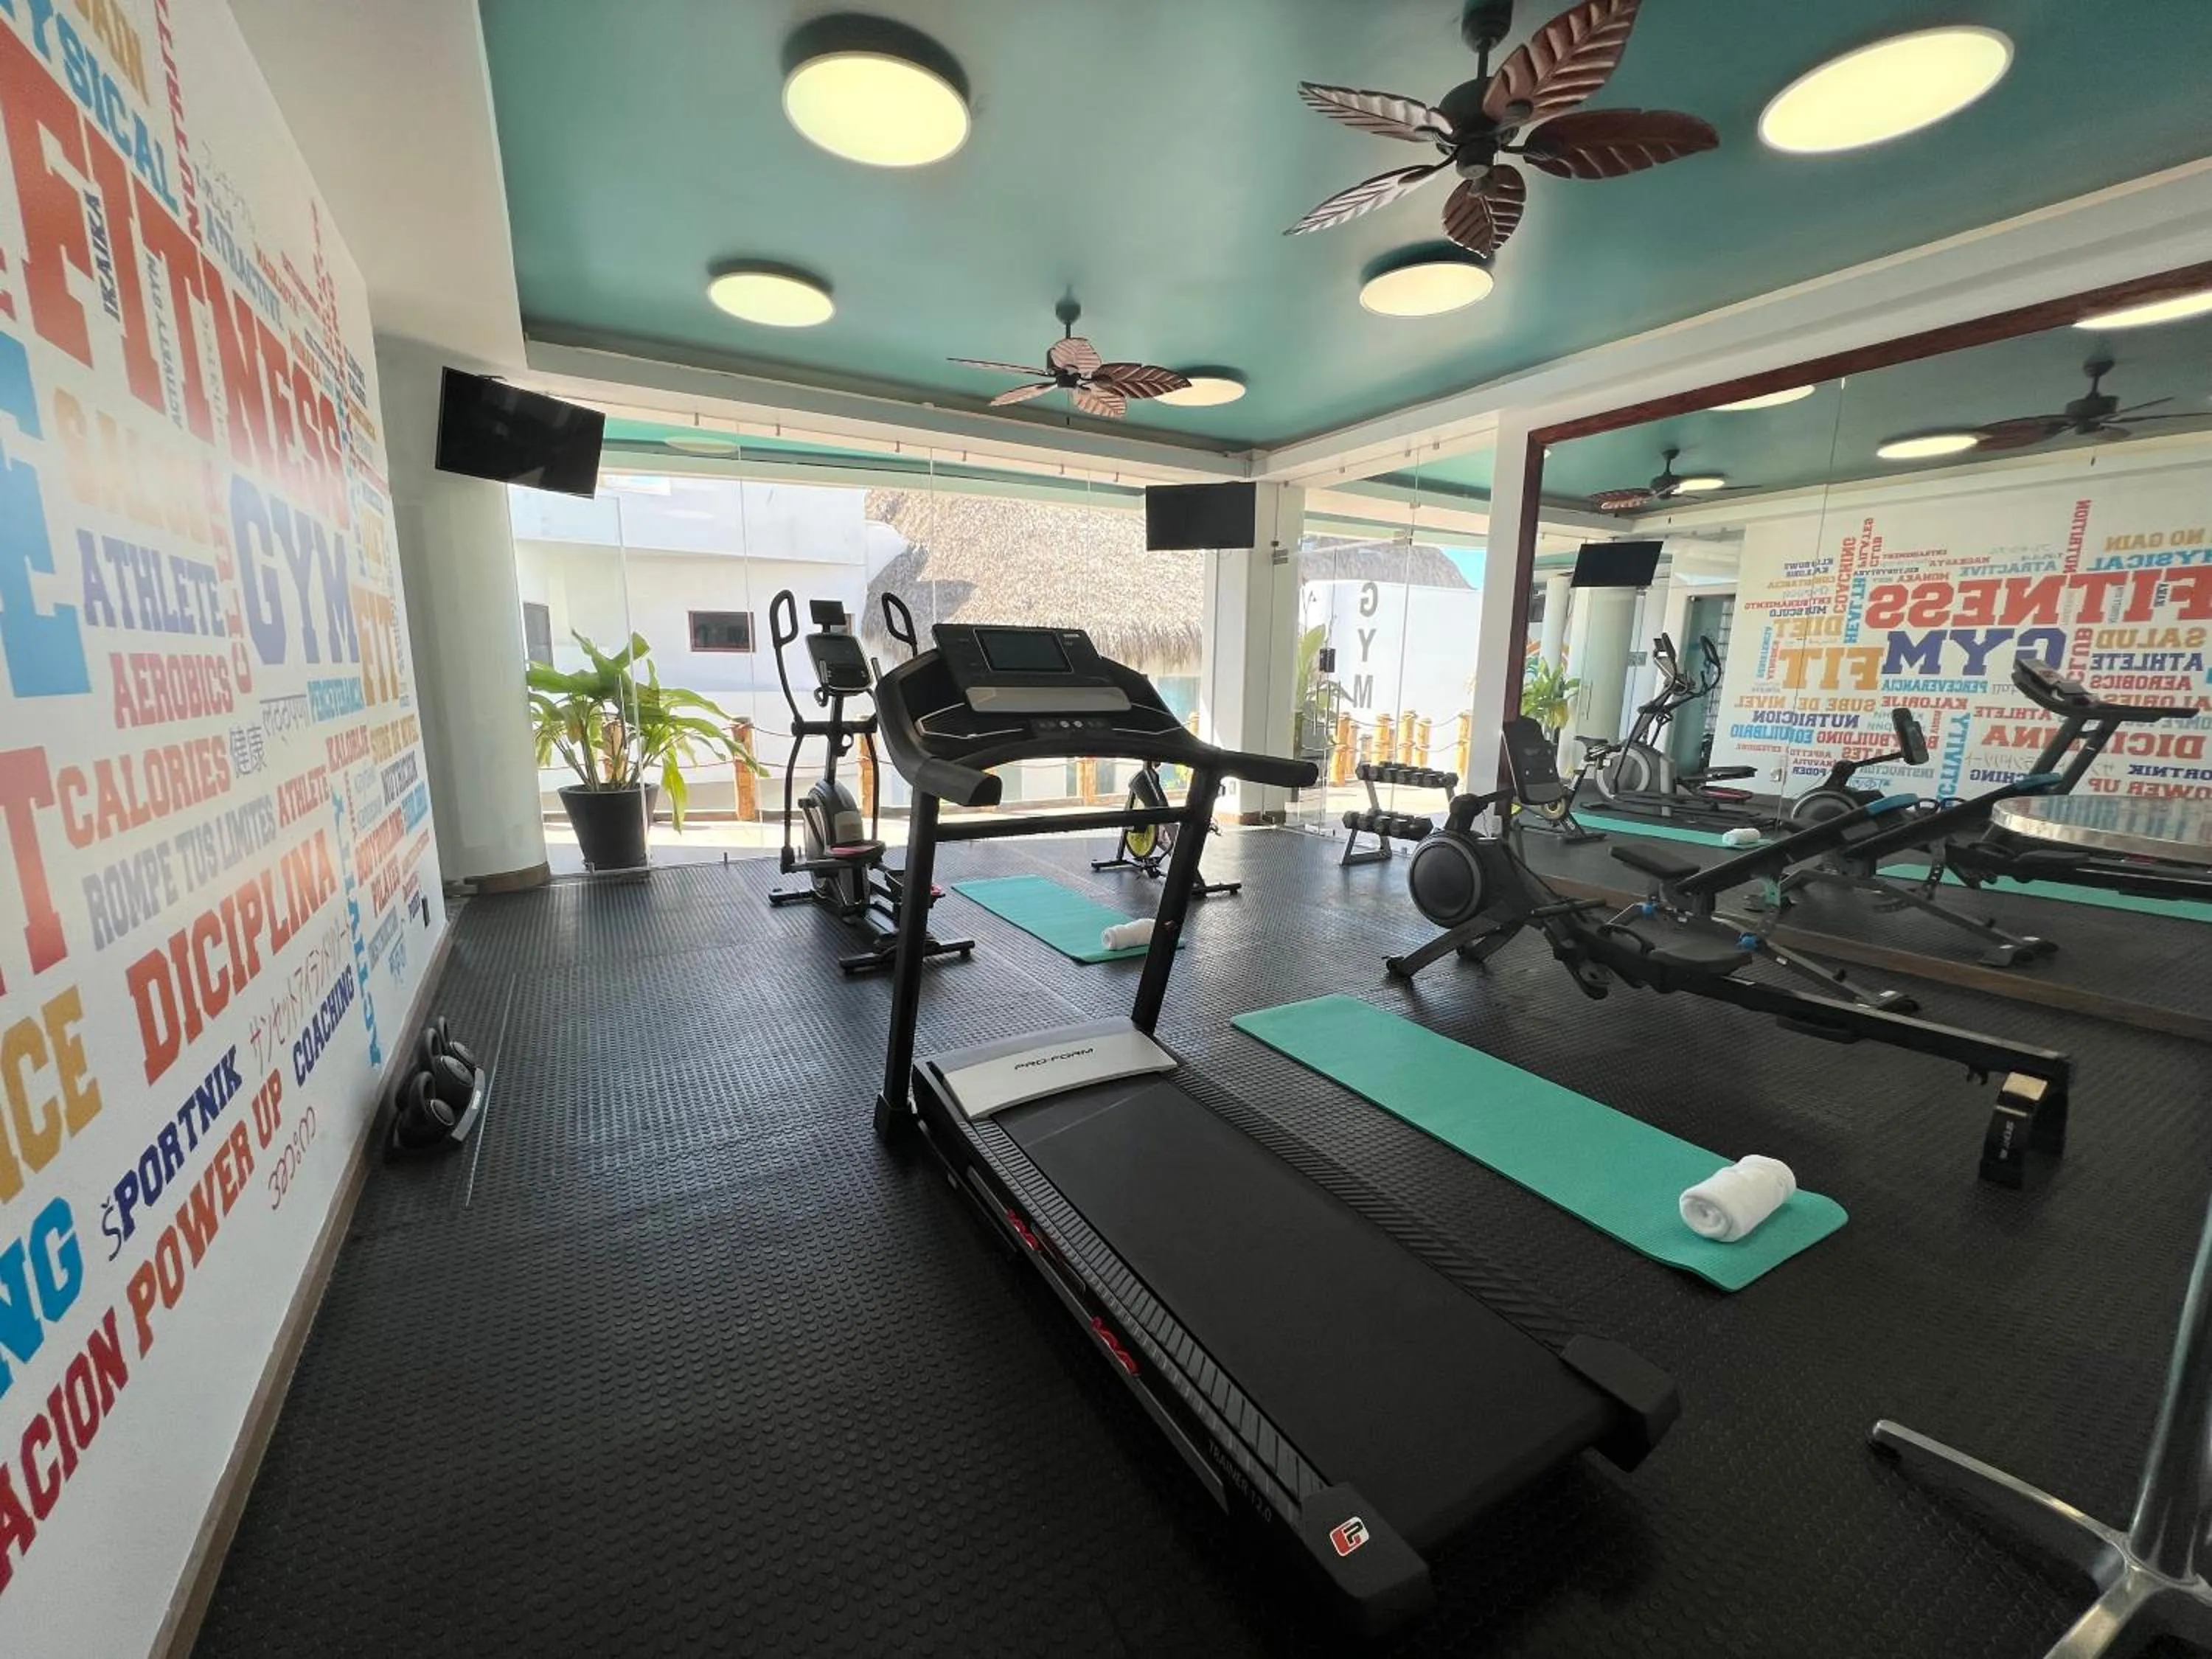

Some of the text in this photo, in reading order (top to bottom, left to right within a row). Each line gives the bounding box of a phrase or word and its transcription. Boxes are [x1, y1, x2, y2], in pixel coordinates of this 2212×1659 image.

[0, 0, 179, 217] YSICAL
[0, 15, 350, 531] FITNESS
[77, 528, 226, 639] ATHLETE
[229, 474, 360, 664] GYM
[109, 652, 233, 728] AEROBICS
[55, 736, 231, 849] CALORIES
[276, 764, 333, 829] ATHLETE
[82, 861, 178, 951] ROMPE
[176, 825, 218, 894] TUS
[221, 793, 276, 870] LIMITES
[126, 829, 337, 1088] DICIPLINA
[293, 961, 355, 1088] COACHING
[127, 1068, 282, 1360] POWER UP
